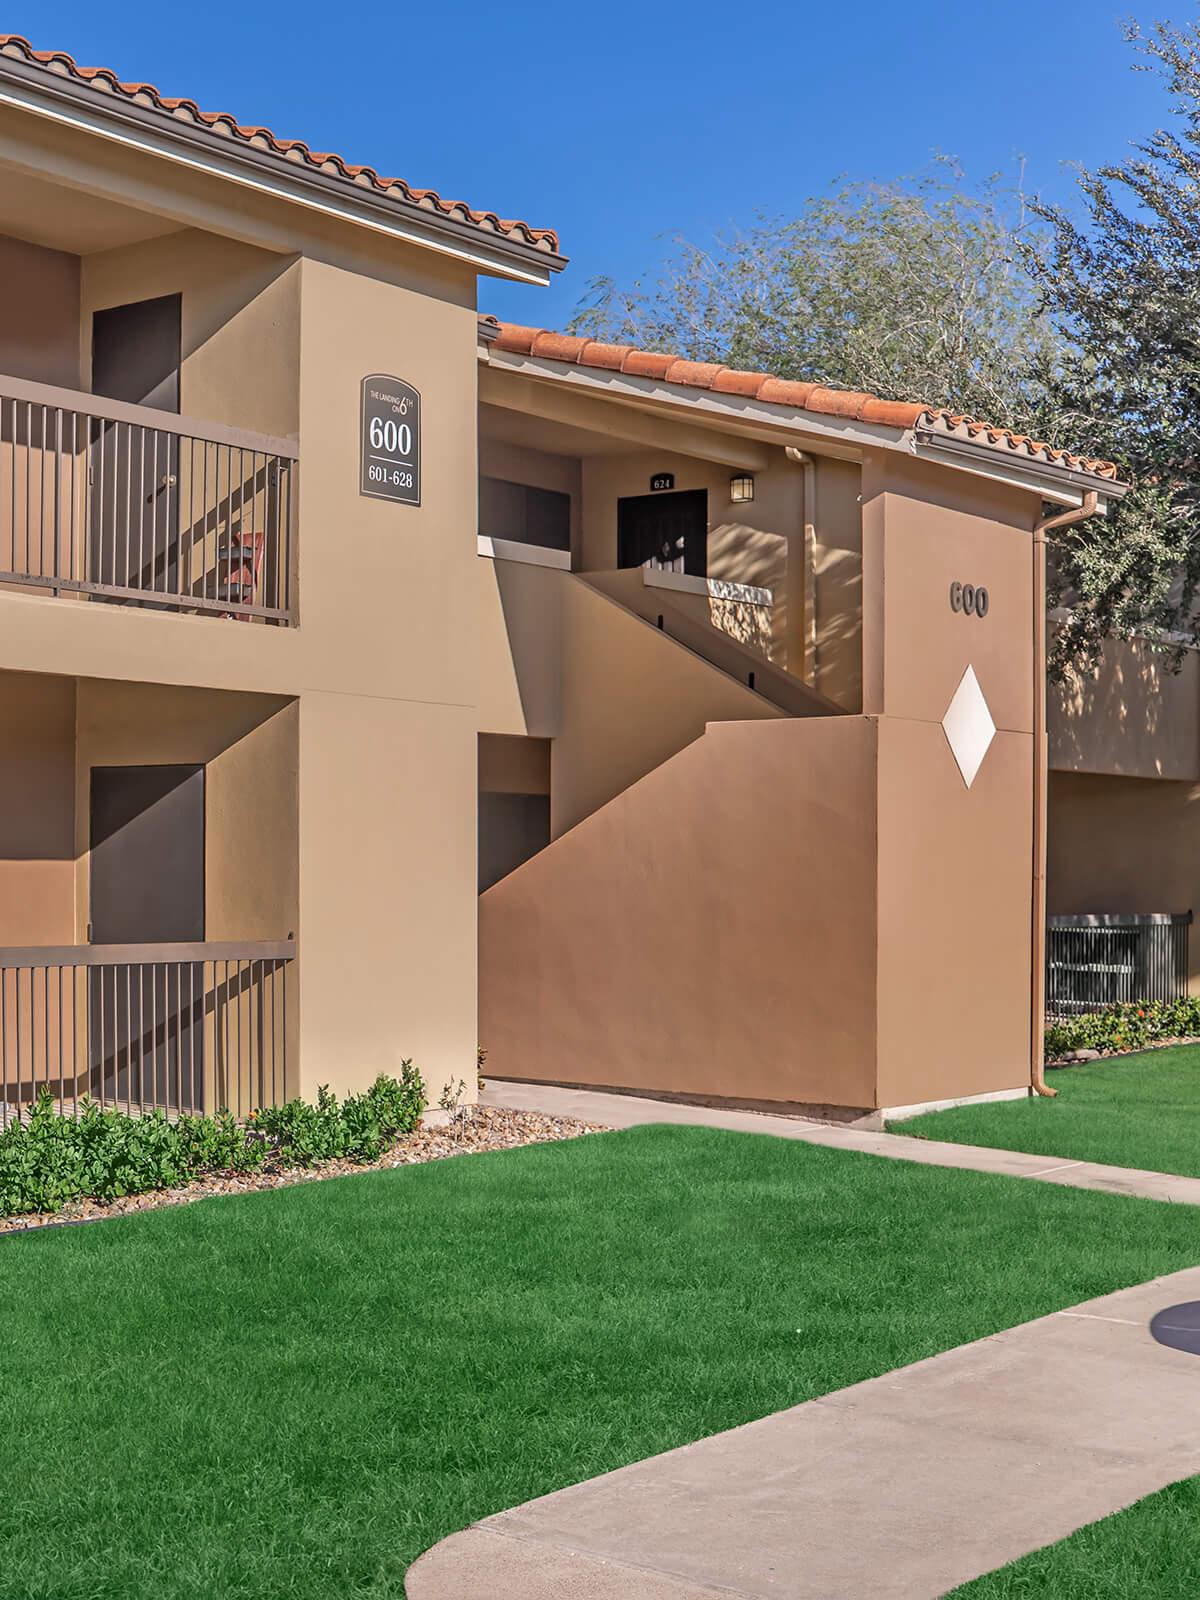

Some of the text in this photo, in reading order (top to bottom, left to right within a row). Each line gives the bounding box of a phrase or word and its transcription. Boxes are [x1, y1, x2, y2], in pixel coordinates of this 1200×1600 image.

[370, 390, 400, 405] THE LANDING
[369, 417, 411, 455] 600
[368, 465, 413, 488] 601-628
[654, 479, 670, 489] 624
[950, 581, 989, 618] 600
